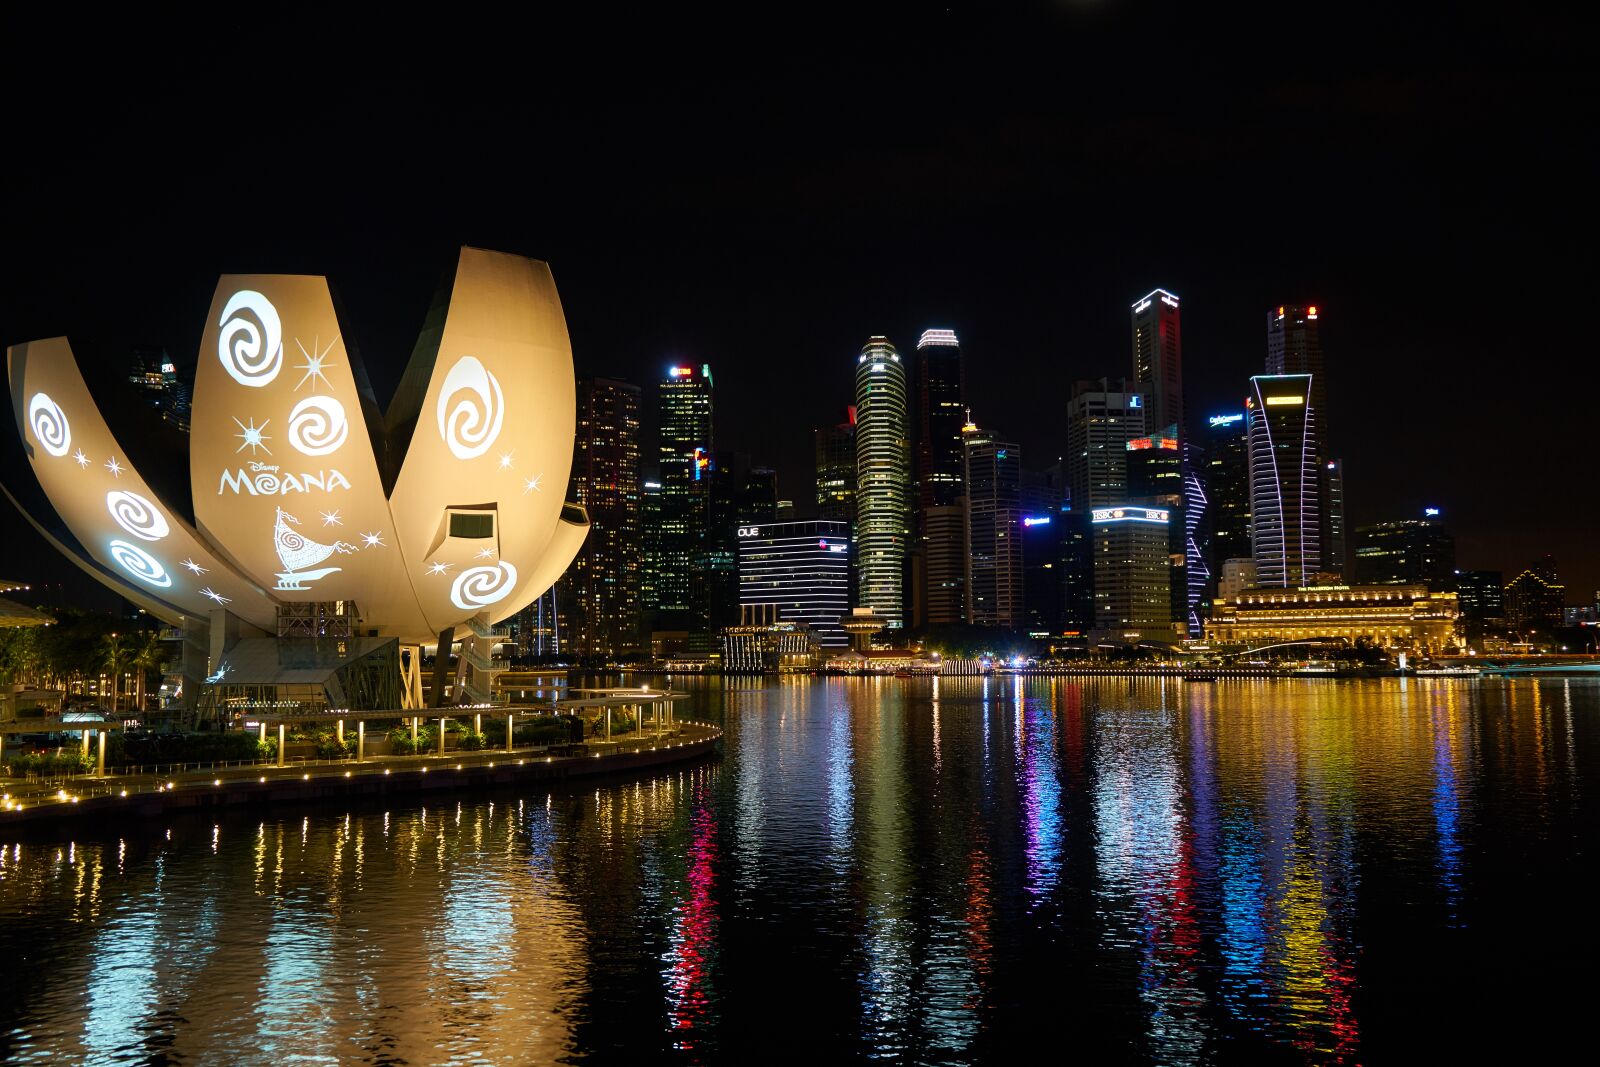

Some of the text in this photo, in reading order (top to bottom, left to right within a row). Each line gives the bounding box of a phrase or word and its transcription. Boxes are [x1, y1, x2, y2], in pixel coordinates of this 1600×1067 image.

[247, 461, 280, 473] Disney
[217, 468, 352, 496] MOANA
[1093, 511, 1113, 520] HSBC
[1145, 510, 1160, 520] HSBC
[738, 527, 759, 537] OUE
